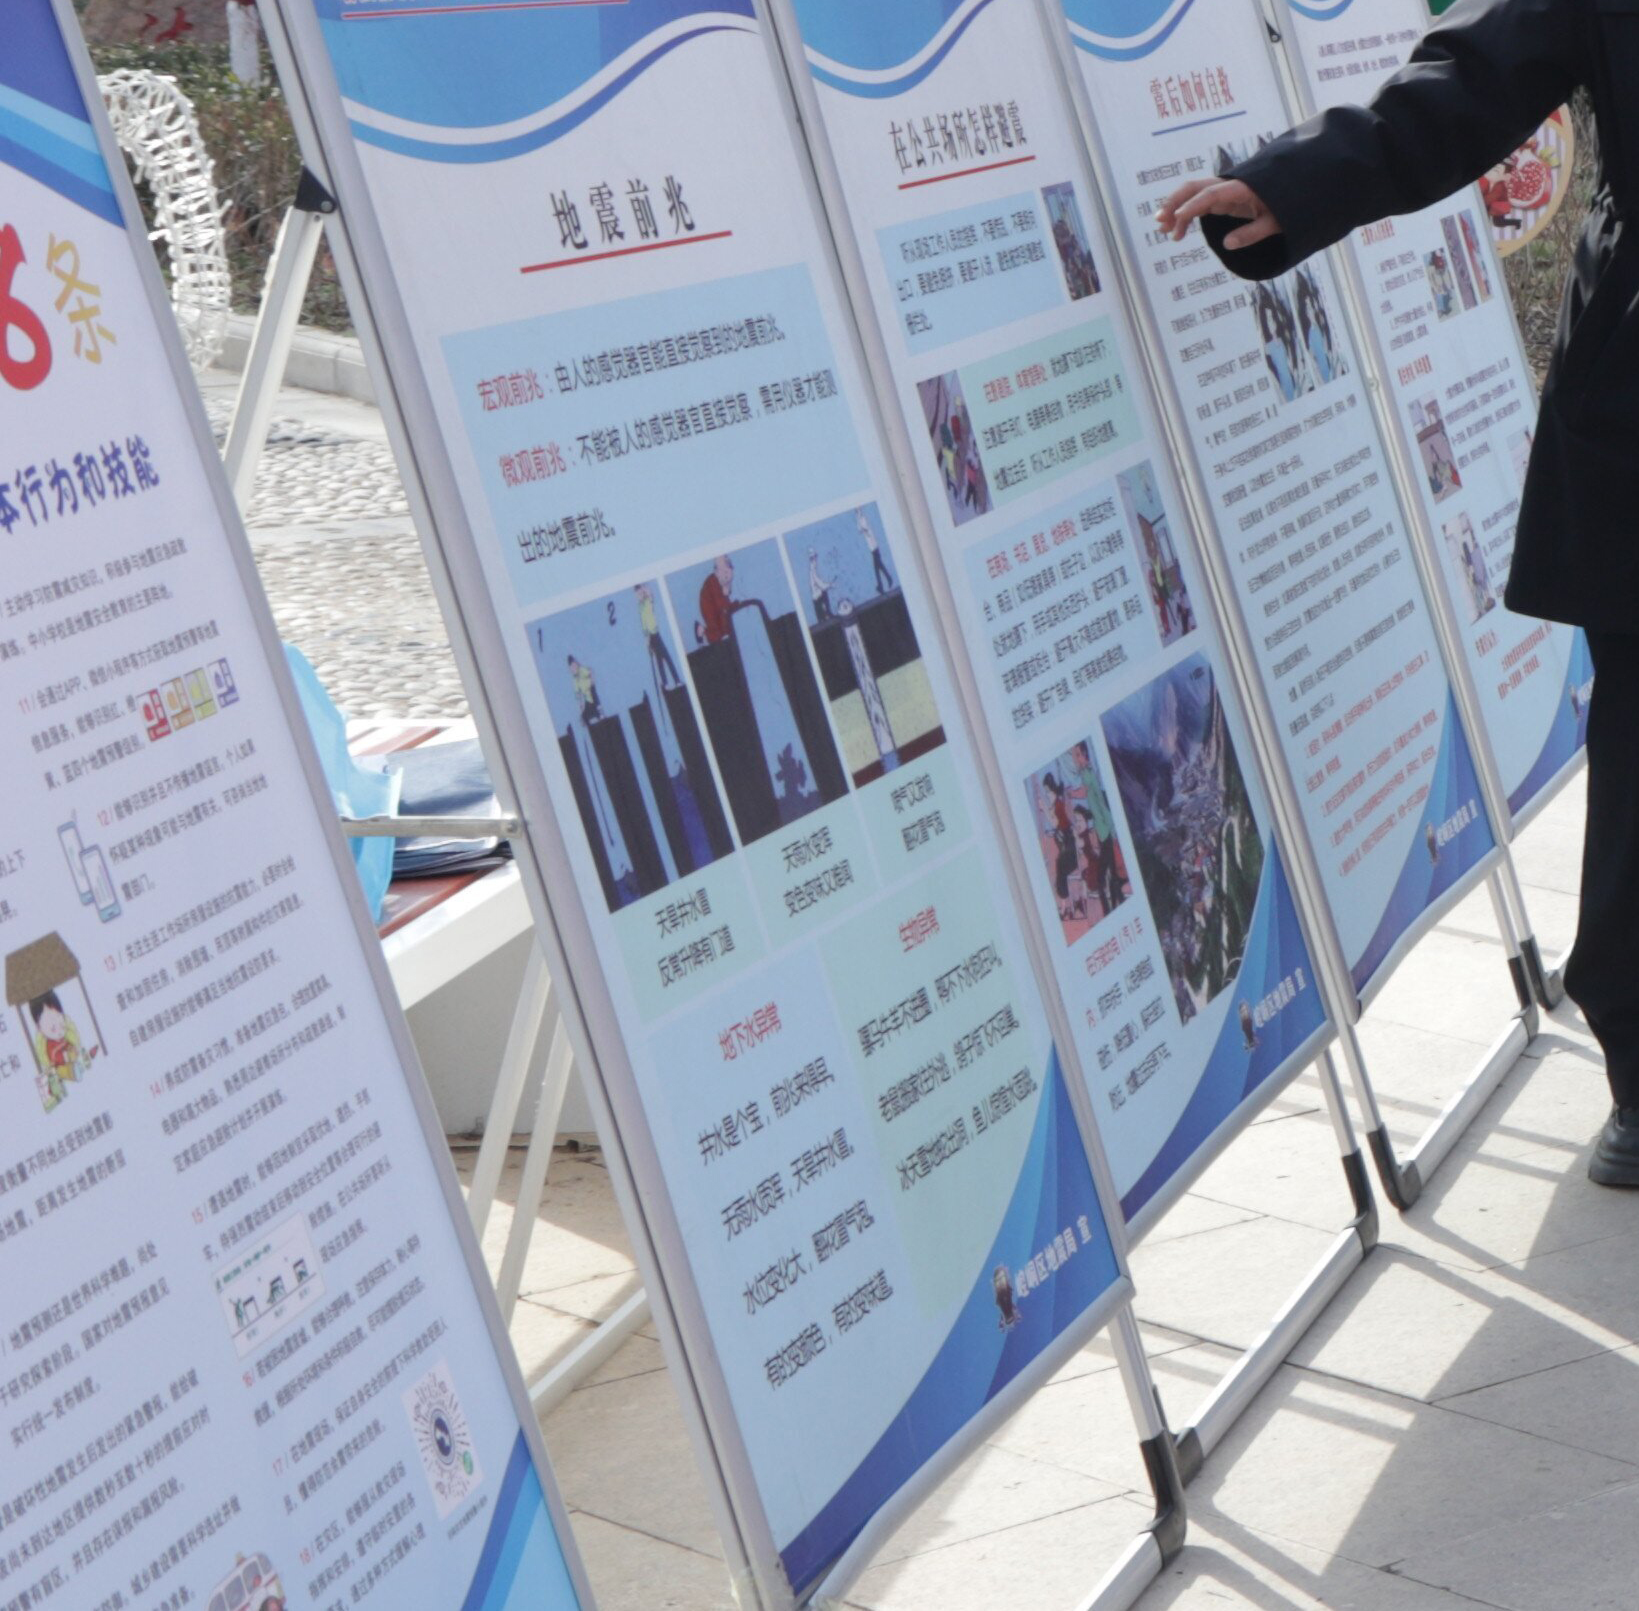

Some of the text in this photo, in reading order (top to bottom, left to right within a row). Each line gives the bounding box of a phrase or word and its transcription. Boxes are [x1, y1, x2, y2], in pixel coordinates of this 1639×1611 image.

[1146, 64, 1236, 122] 震后如何自救
[884, 99, 1030, 174] 在公共场所怎样避震
[545, 169, 696, 256] 地震前兆
[717, 998, 783, 1066] 地下水异常
